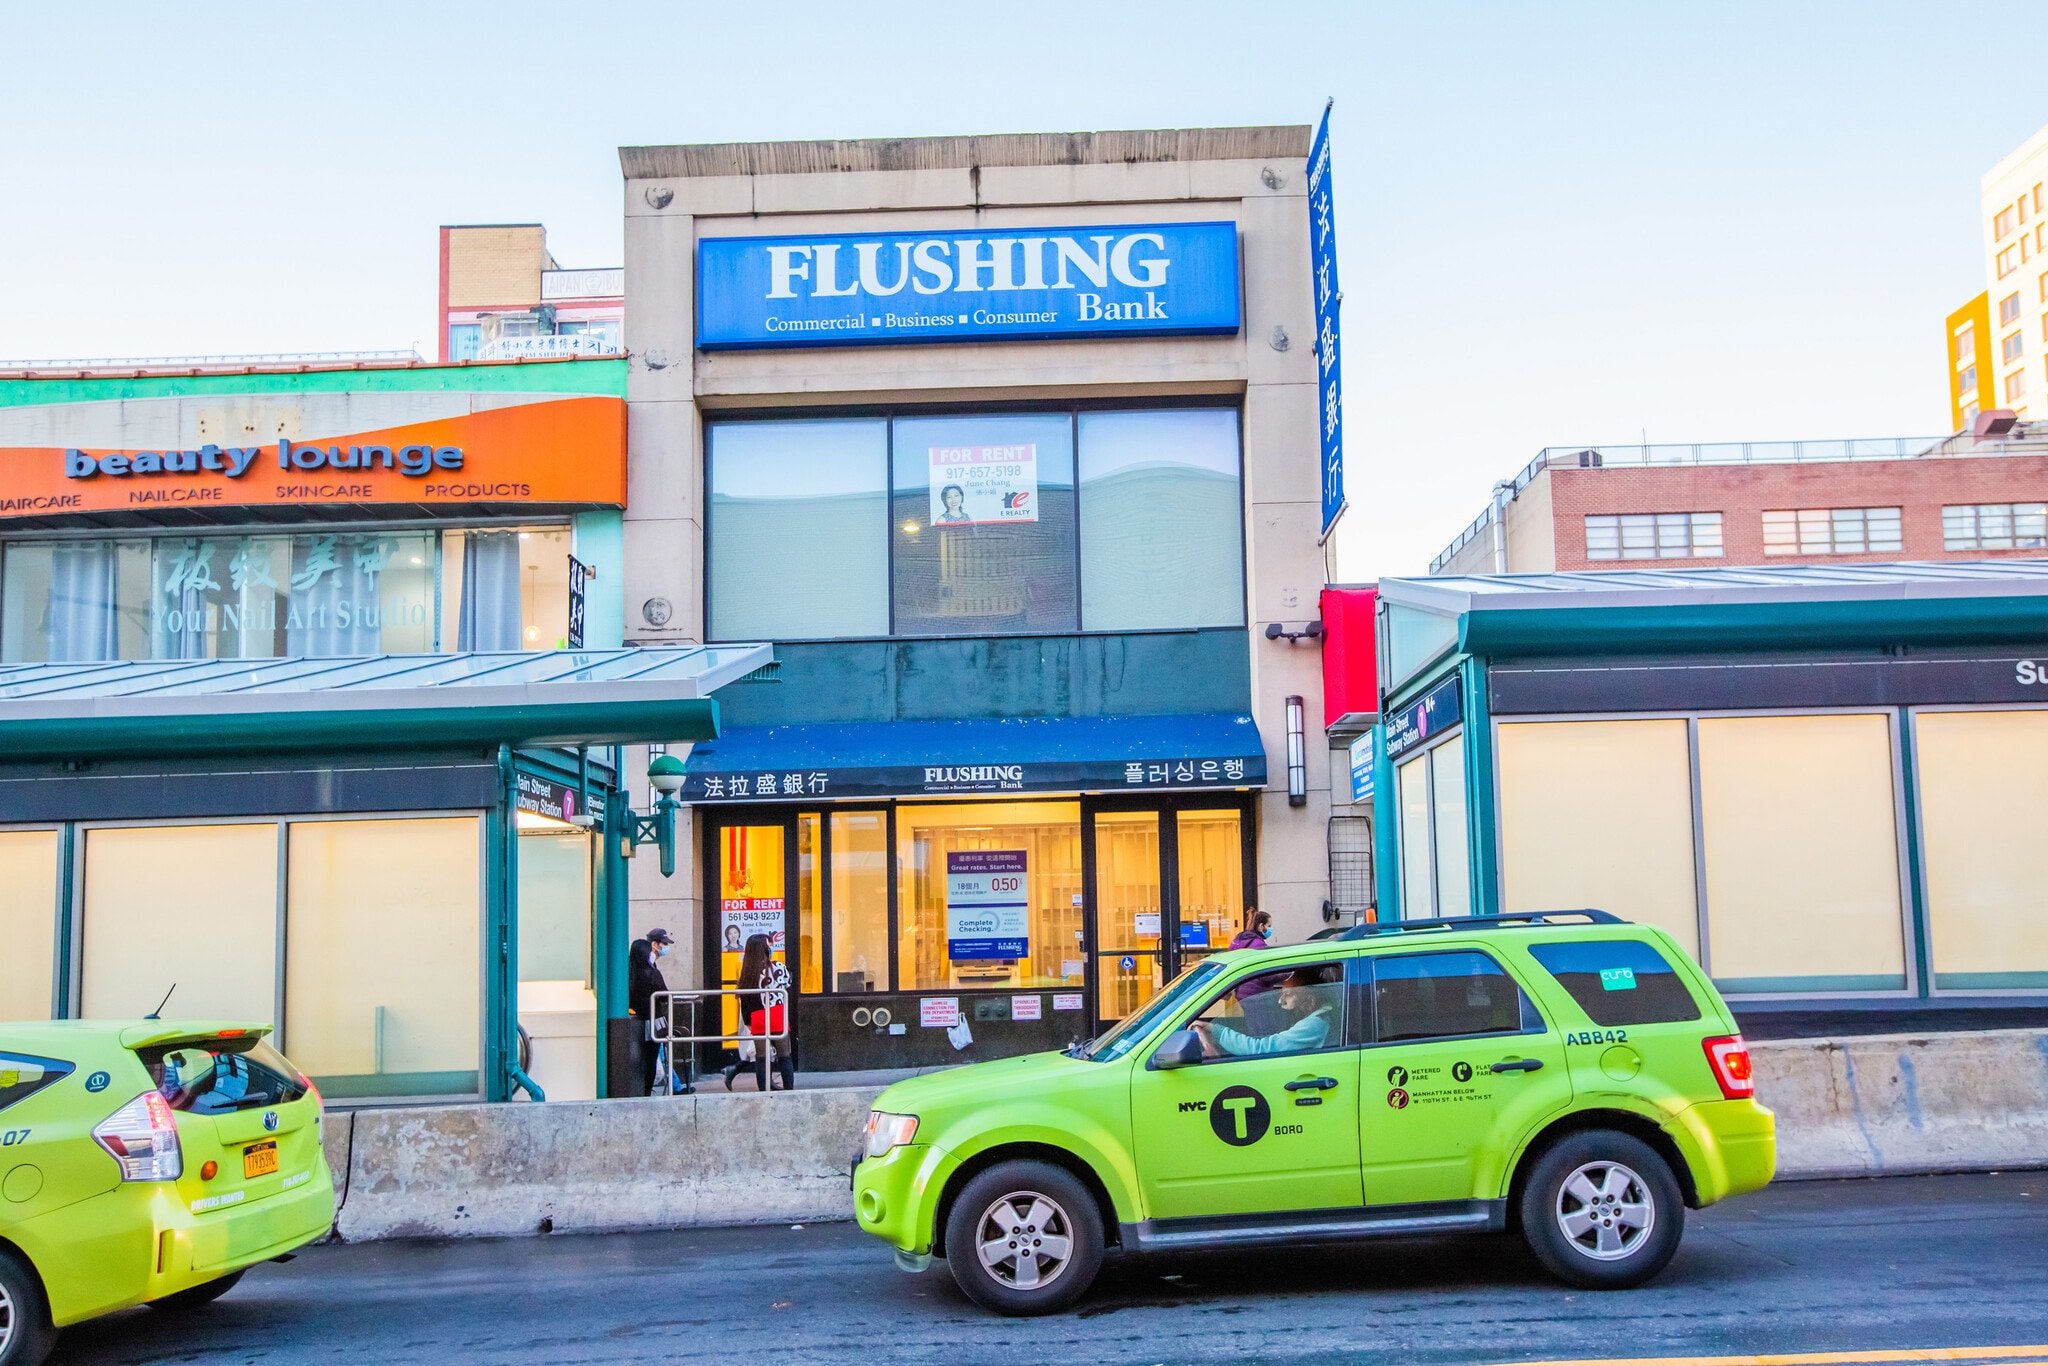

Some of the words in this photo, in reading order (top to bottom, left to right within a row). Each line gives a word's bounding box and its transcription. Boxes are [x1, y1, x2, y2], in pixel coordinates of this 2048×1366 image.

[765, 233, 1171, 299] FLUSHING
[543, 274, 580, 294] TAIPAN
[1076, 291, 1169, 321] Bank
[765, 313, 866, 332] Commercial
[885, 312, 954, 329] Business
[973, 309, 1058, 325] Consumer
[1314, 191, 1342, 505] 法拉盛銀行
[65, 444, 260, 479] beauty
[278, 438, 464, 476] lounge
[940, 448, 973, 463] FOR
[981, 446, 1025, 461] RENT
[946, 465, 1022, 479] 917-657-5198
[130, 488, 222, 503] NAILCARE
[276, 485, 372, 498] SKINCARE
[425, 484, 530, 497] PRODUCTS
[964, 480, 984, 488] June
[985, 479, 1011, 487] Chang
[1005, 509, 1031, 517] REALTY
[151, 605, 213, 633] Your
[222, 599, 276, 632] Nail
[284, 600, 327, 630] Art
[335, 597, 427, 630] Studio
[1395, 713, 1410, 735] Street
[1386, 739, 1403, 756] Subway
[1402, 726, 1420, 747] Station
[924, 765, 1024, 783] FLUSHING
[1124, 758, 1245, 784] 플러싱은행
[531, 778, 551, 798] Street
[703, 771, 829, 798] 法拉盛銀行
[1000, 781, 1024, 789] Bank
[517, 793, 540, 814] ubway
[540, 798, 562, 818] Station
[566, 796, 572, 815] 7
[957, 882, 980, 890] 18個月
[724, 899, 747, 910] FOR
[753, 898, 784, 909] RENT
[728, 911, 781, 921] 561-543-9237
[1601, 969, 1633, 980] curb
[1178, 1101, 1207, 1112] NYC
[1222, 1097, 1256, 1139] T
[1274, 1124, 1303, 1135] BORO
[220, 1190, 245, 1205] WANTED
